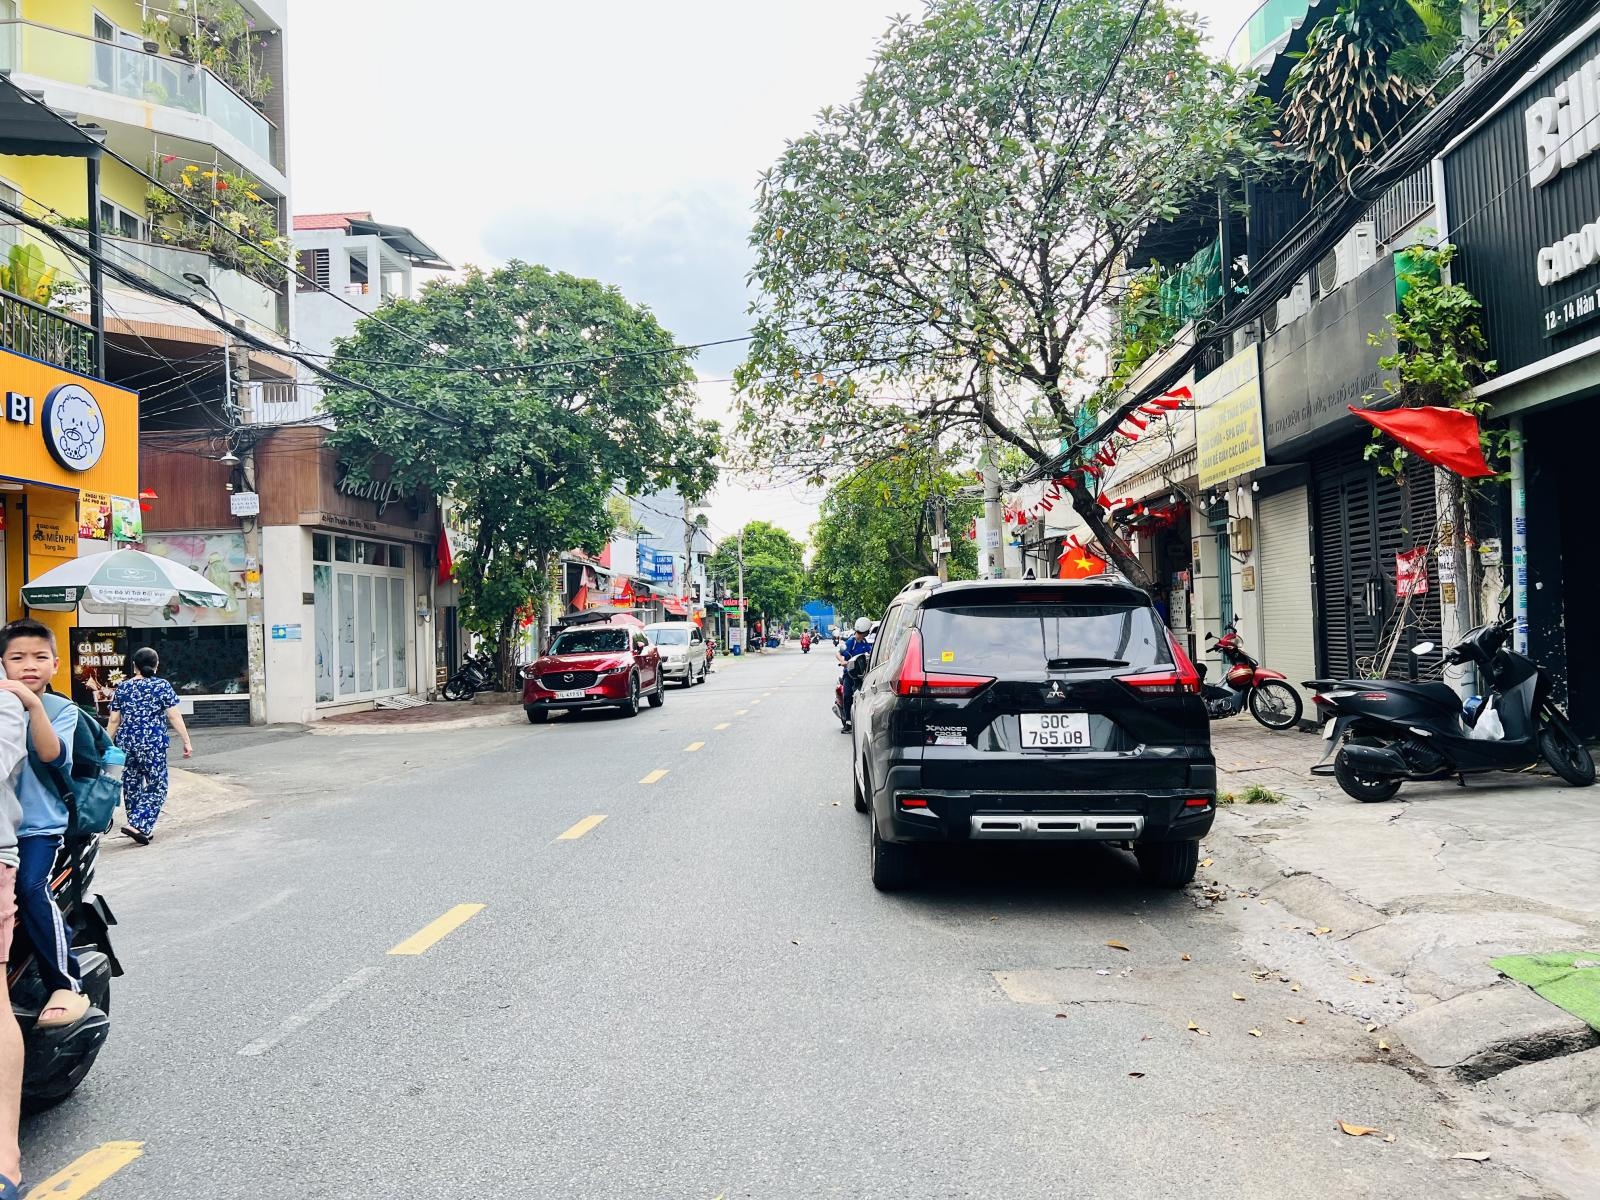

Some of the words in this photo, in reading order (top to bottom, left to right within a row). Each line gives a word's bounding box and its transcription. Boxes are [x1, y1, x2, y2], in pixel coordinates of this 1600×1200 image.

[1537, 216, 1600, 287] CARO
[1545, 310, 1557, 331] 12
[1563, 302, 1575, 323] 14
[1576, 294, 1595, 318] Hàn
[8, 391, 35, 425] BI
[64, 532, 76, 545] PHÍ
[79, 655, 101, 666] PHA
[925, 724, 968, 732] XPANDER
[1040, 714, 1070, 729] 60C
[1028, 730, 1083, 745] 765.08
